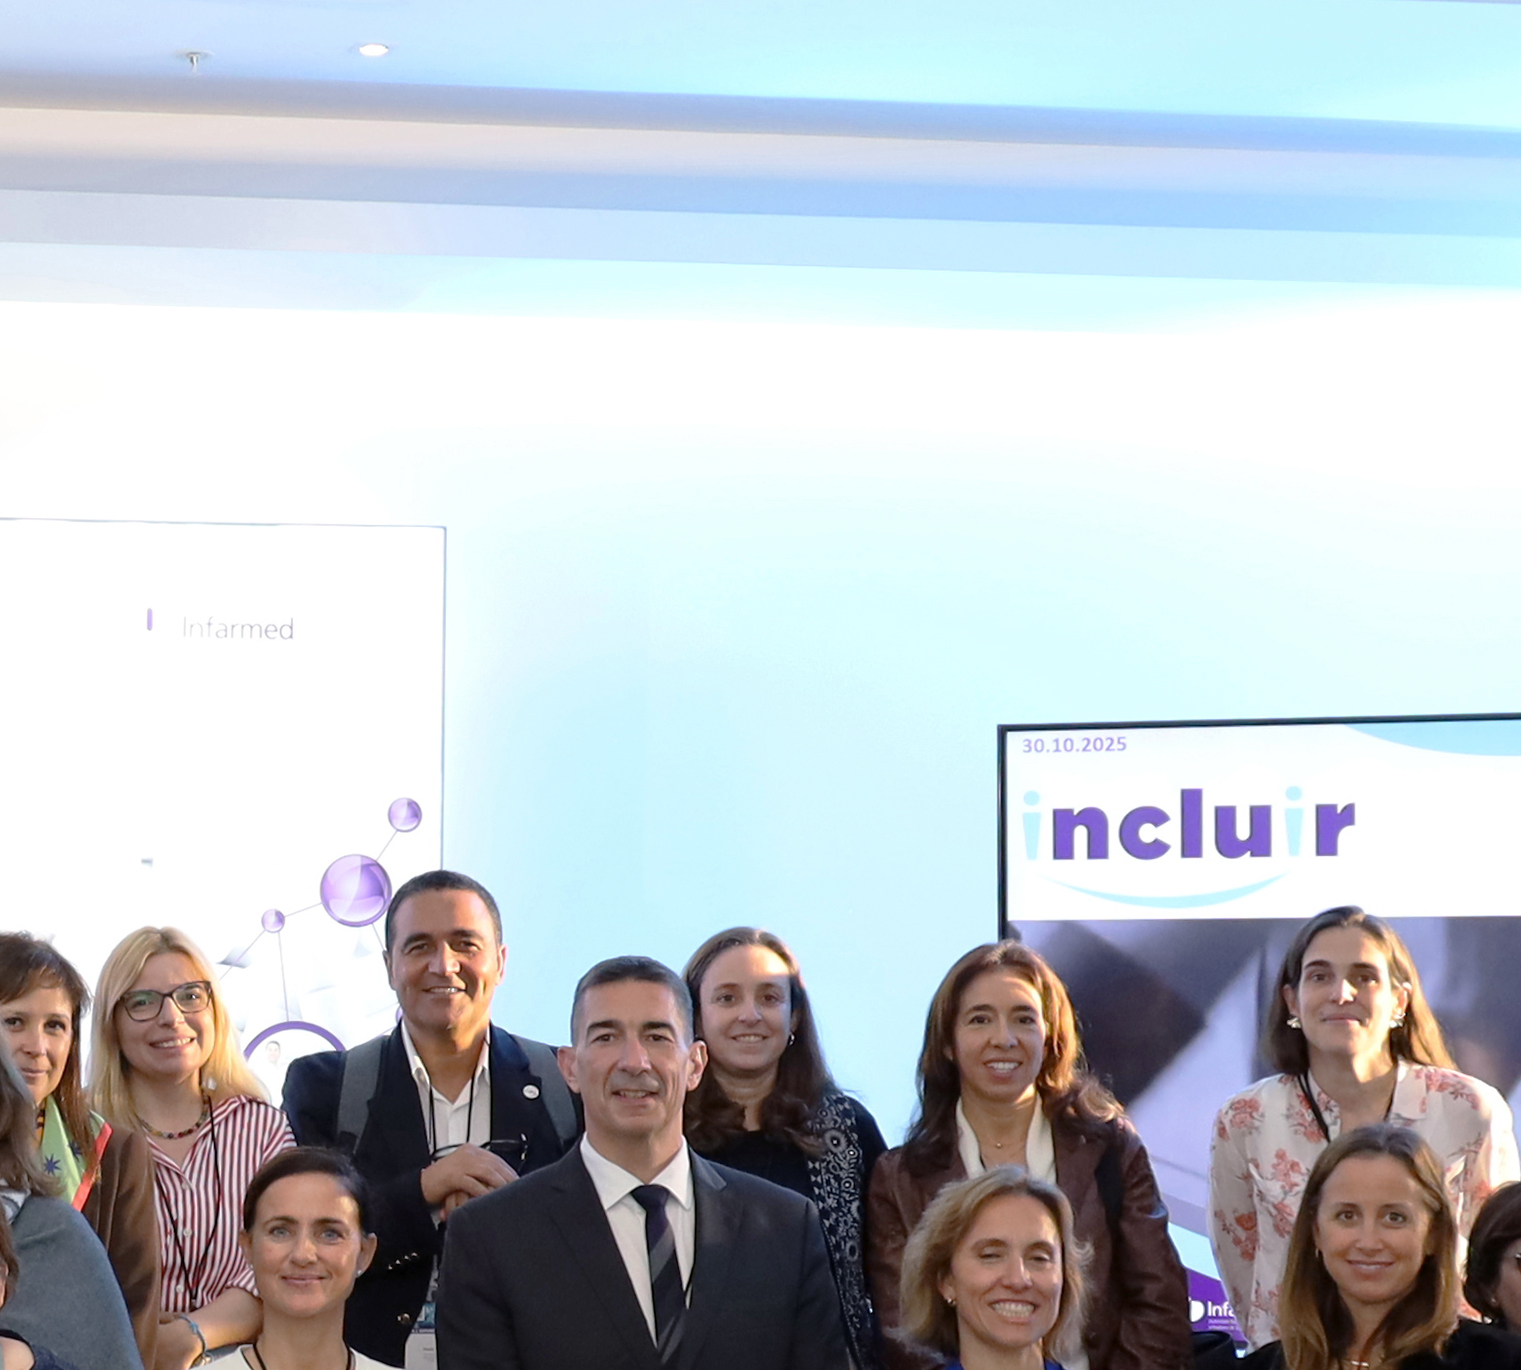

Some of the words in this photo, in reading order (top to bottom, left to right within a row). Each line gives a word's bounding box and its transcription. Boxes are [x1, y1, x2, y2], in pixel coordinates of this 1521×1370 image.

[183, 615, 294, 640] Infarmed
[1022, 736, 1128, 754] 30.10.2025
[1021, 785, 1356, 862] incluir
